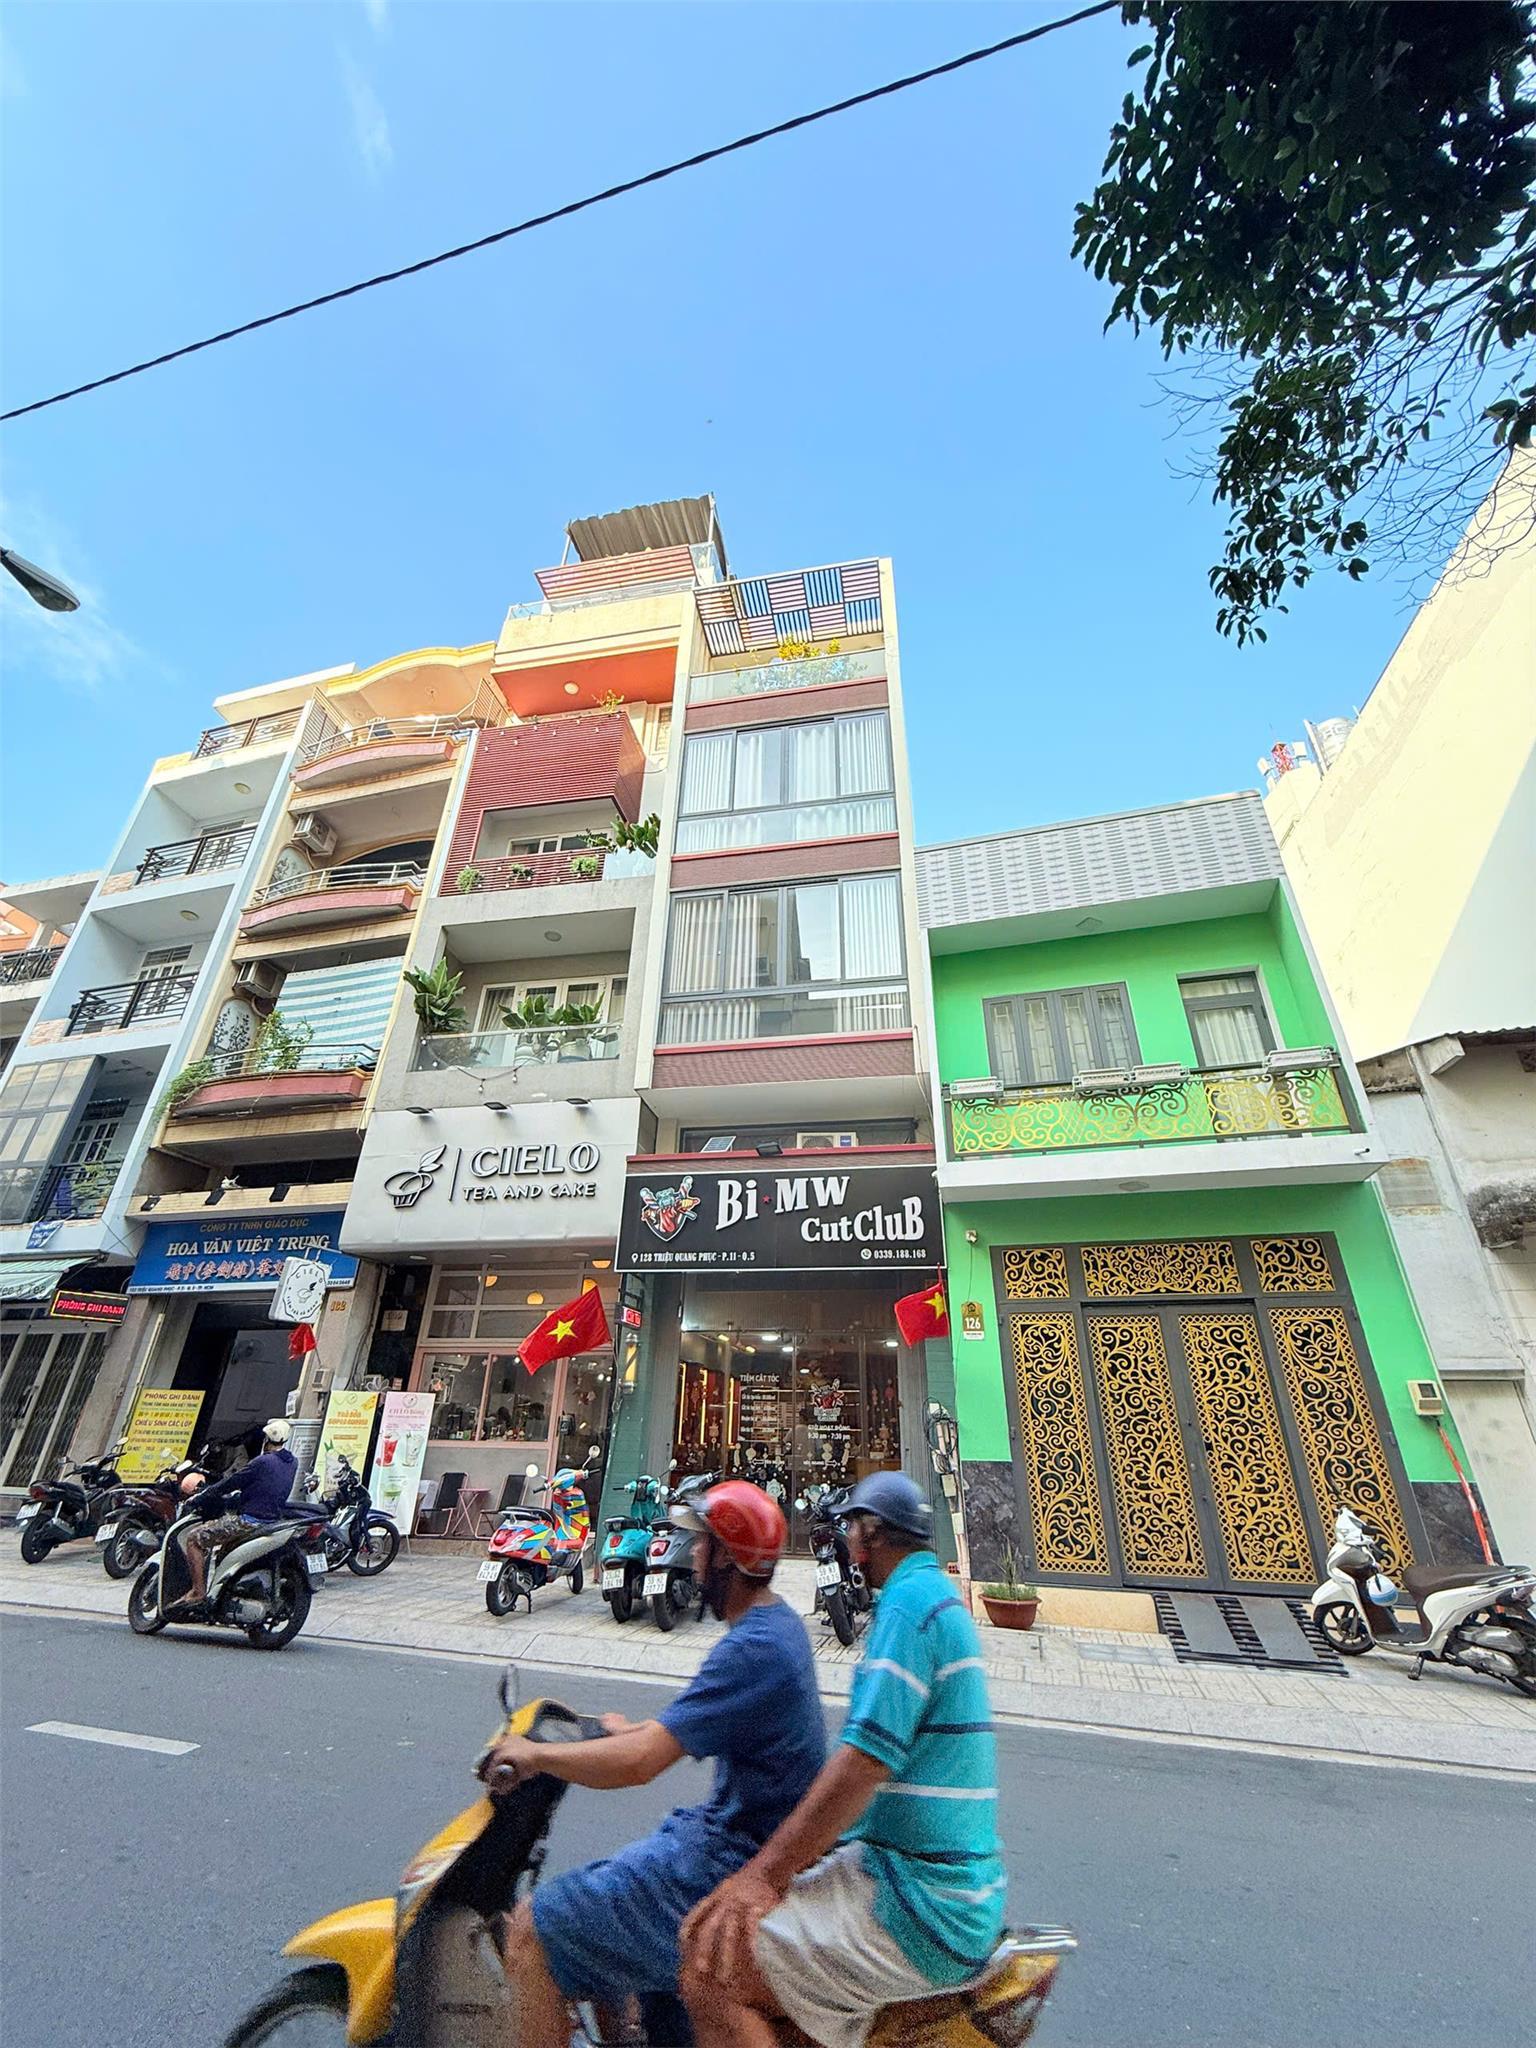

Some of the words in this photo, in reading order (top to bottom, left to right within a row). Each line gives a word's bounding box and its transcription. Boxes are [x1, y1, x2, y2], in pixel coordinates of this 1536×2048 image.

[470, 1142, 600, 1177] CIELO
[463, 1185, 497, 1200] TEA
[503, 1184, 543, 1199] AND
[549, 1182, 597, 1198] CAKE
[715, 1179, 758, 1231] Bi
[774, 1176, 850, 1214] MW
[228, 1222, 239, 1231] TY
[240, 1220, 263, 1230] TNHH
[801, 1196, 925, 1242] CutCluB
[166, 1242, 199, 1257] HOA
[203, 1236, 234, 1254] VĂN
[237, 1235, 273, 1255] VIỆT
[278, 1235, 330, 1250] TRUNG
[640, 1253, 653, 1262] 128
[654, 1251, 674, 1264] TRIỆU
[674, 1252, 697, 1262] QUANG
[698, 1252, 717, 1263] PHỤC
[874, 1249, 926, 1260] 0339.188.168
[87, 1303, 101, 1312] GHI
[102, 1305, 125, 1315] DANH
[964, 1317, 981, 1330] 126
